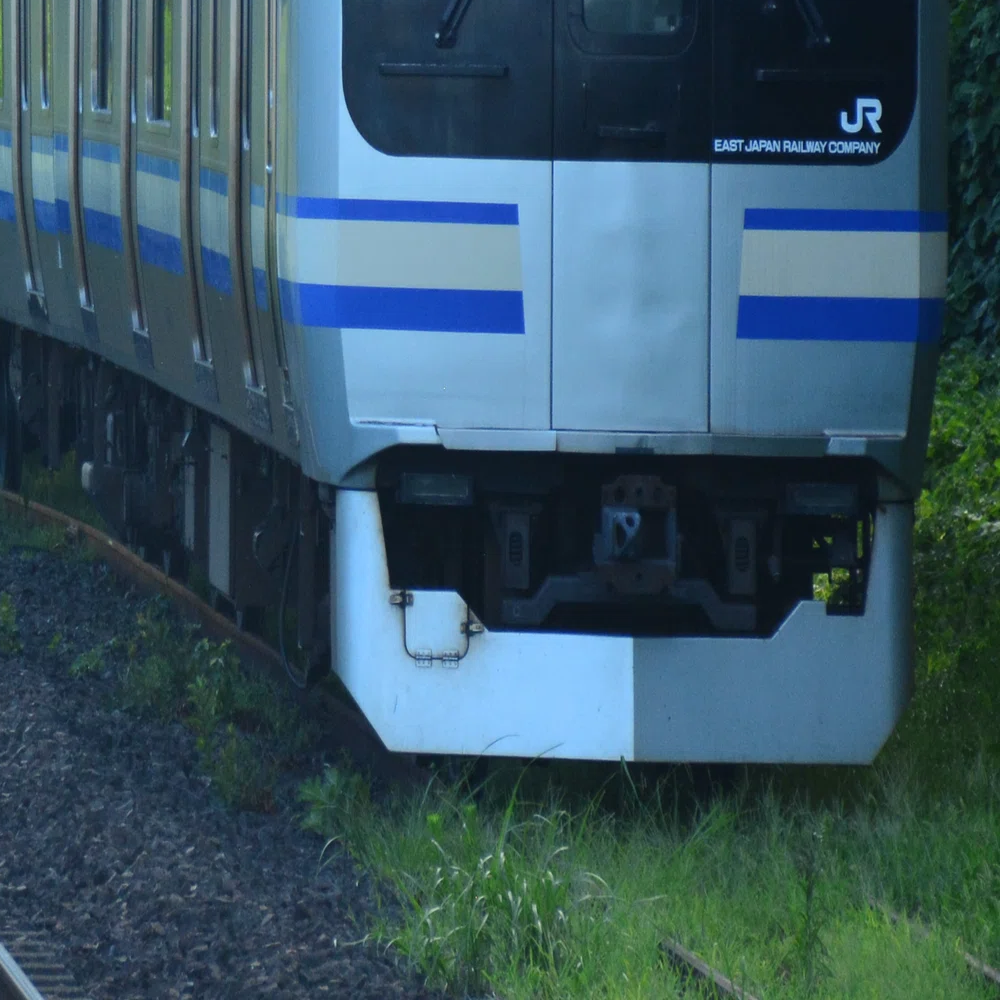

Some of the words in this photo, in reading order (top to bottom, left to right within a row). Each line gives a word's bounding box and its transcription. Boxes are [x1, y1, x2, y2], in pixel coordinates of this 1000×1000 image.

[841, 98, 883, 134] JR
[714, 139, 744, 152] EAST
[745, 139, 781, 153] JAPAN
[783, 140, 827, 154] RAILWAY
[828, 141, 881, 154] COMPANY
